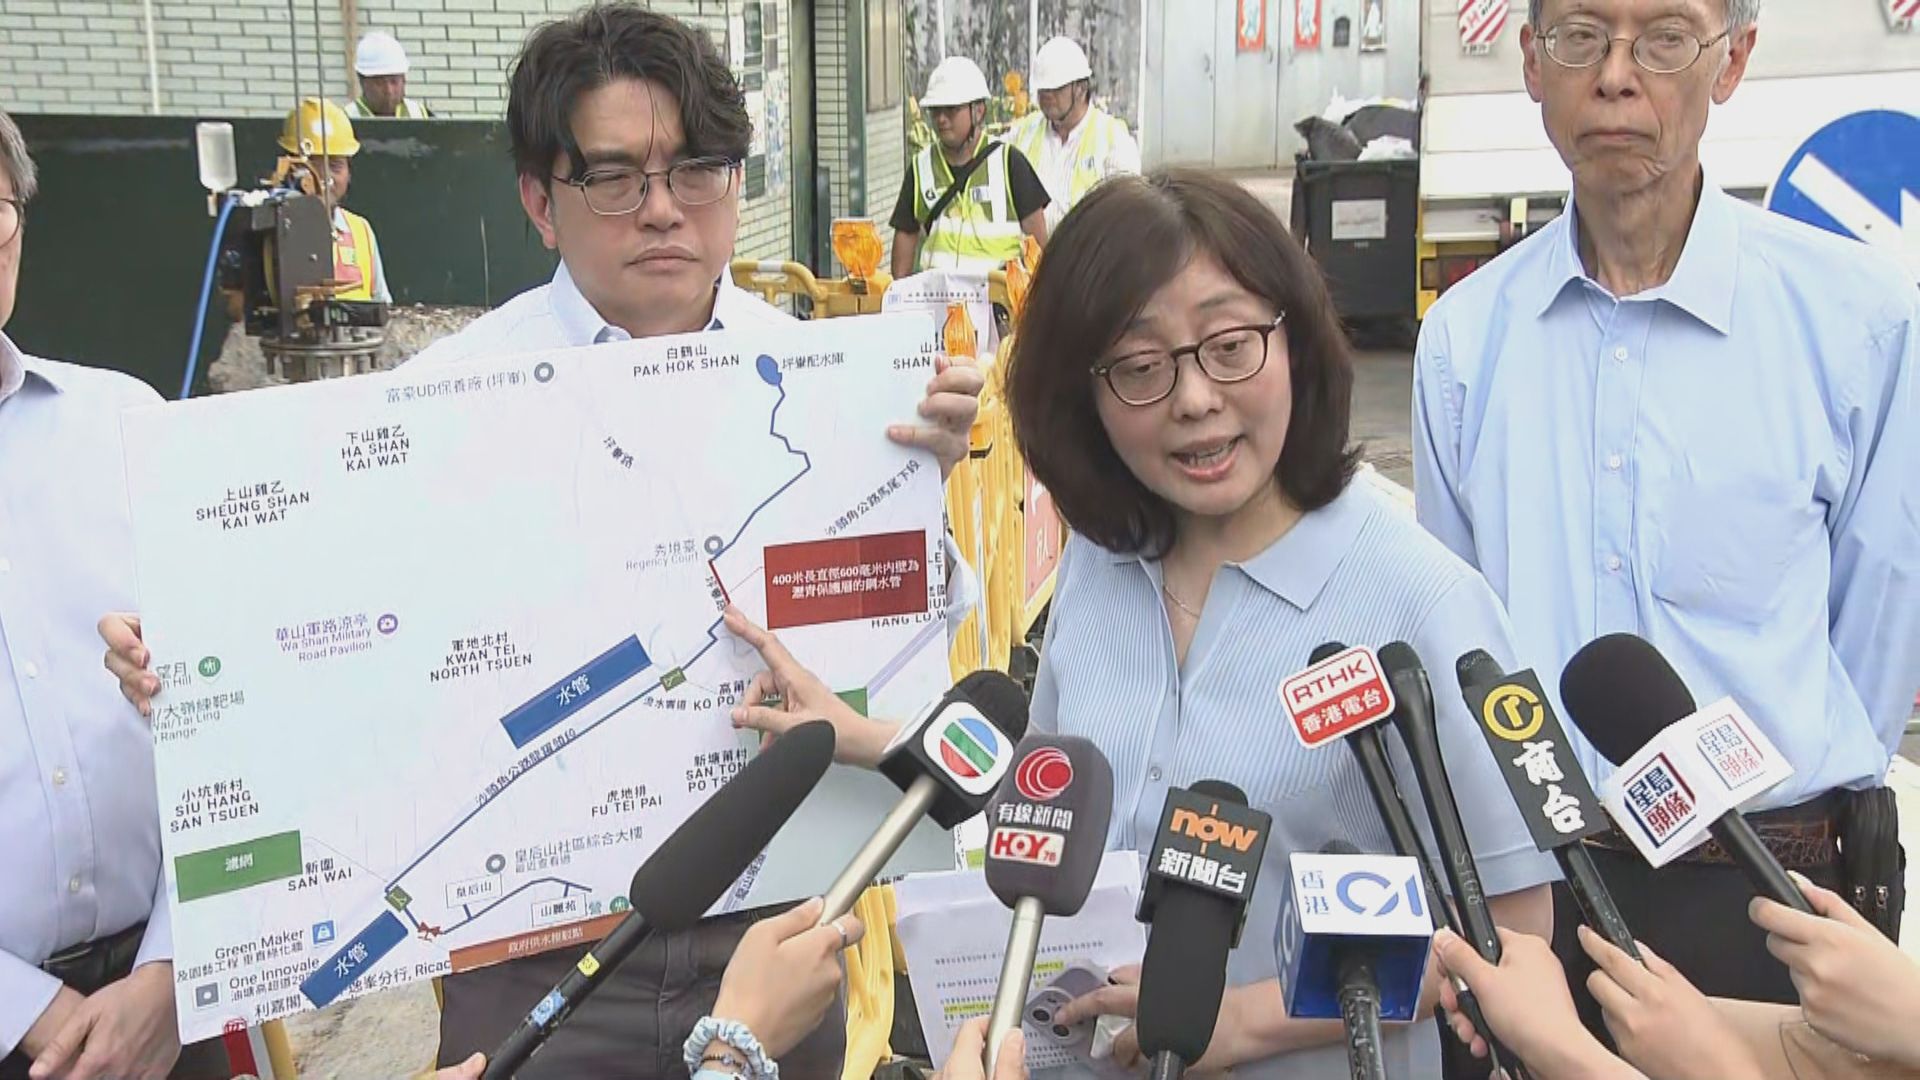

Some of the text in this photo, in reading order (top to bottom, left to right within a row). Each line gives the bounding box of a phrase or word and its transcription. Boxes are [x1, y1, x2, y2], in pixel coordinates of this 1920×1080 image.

[633, 354, 741, 378] PAK HOK SHAN
[893, 356, 931, 370] SHAN
[341, 438, 411, 460] HA SHAN
[346, 451, 408, 473] KAI WAT
[196, 491, 311, 522] SHEUNG SHAN
[222, 509, 287, 531] KAI WAT
[872, 615, 910, 629] HANG
[280, 628, 372, 652] Wa Shan Military
[298, 640, 373, 663] Road Pavilion
[446, 643, 517, 666] KWAN TEI
[173, 673, 192, 689] Hill
[430, 655, 533, 683] NORTH TSUEN
[1292, 658, 1369, 705] RTHK
[556, 672, 592, 707] 水管
[693, 698, 712, 711] KO
[717, 694, 736, 707] PO
[1301, 688, 1383, 736] 香港電台
[196, 709, 221, 724] Ling
[160, 727, 198, 742] Range
[686, 761, 747, 781] SAN TON
[688, 780, 706, 793] PO
[1627, 765, 1675, 812] 星島
[175, 790, 251, 817] SIU HANG
[591, 795, 663, 818] FU TEI PAI
[1644, 790, 1692, 838] 頭條
[170, 802, 259, 833] SAN TSUEN
[998, 802, 1073, 832] 有線新聞
[1169, 805, 1259, 853] now
[994, 831, 1050, 860] HOY
[287, 867, 353, 892] SAN WAI
[1157, 847, 1248, 894] 新聞台
[214, 928, 305, 961] Green Maker
[334, 941, 369, 978] 水管
[229, 956, 320, 990] One Innovale
